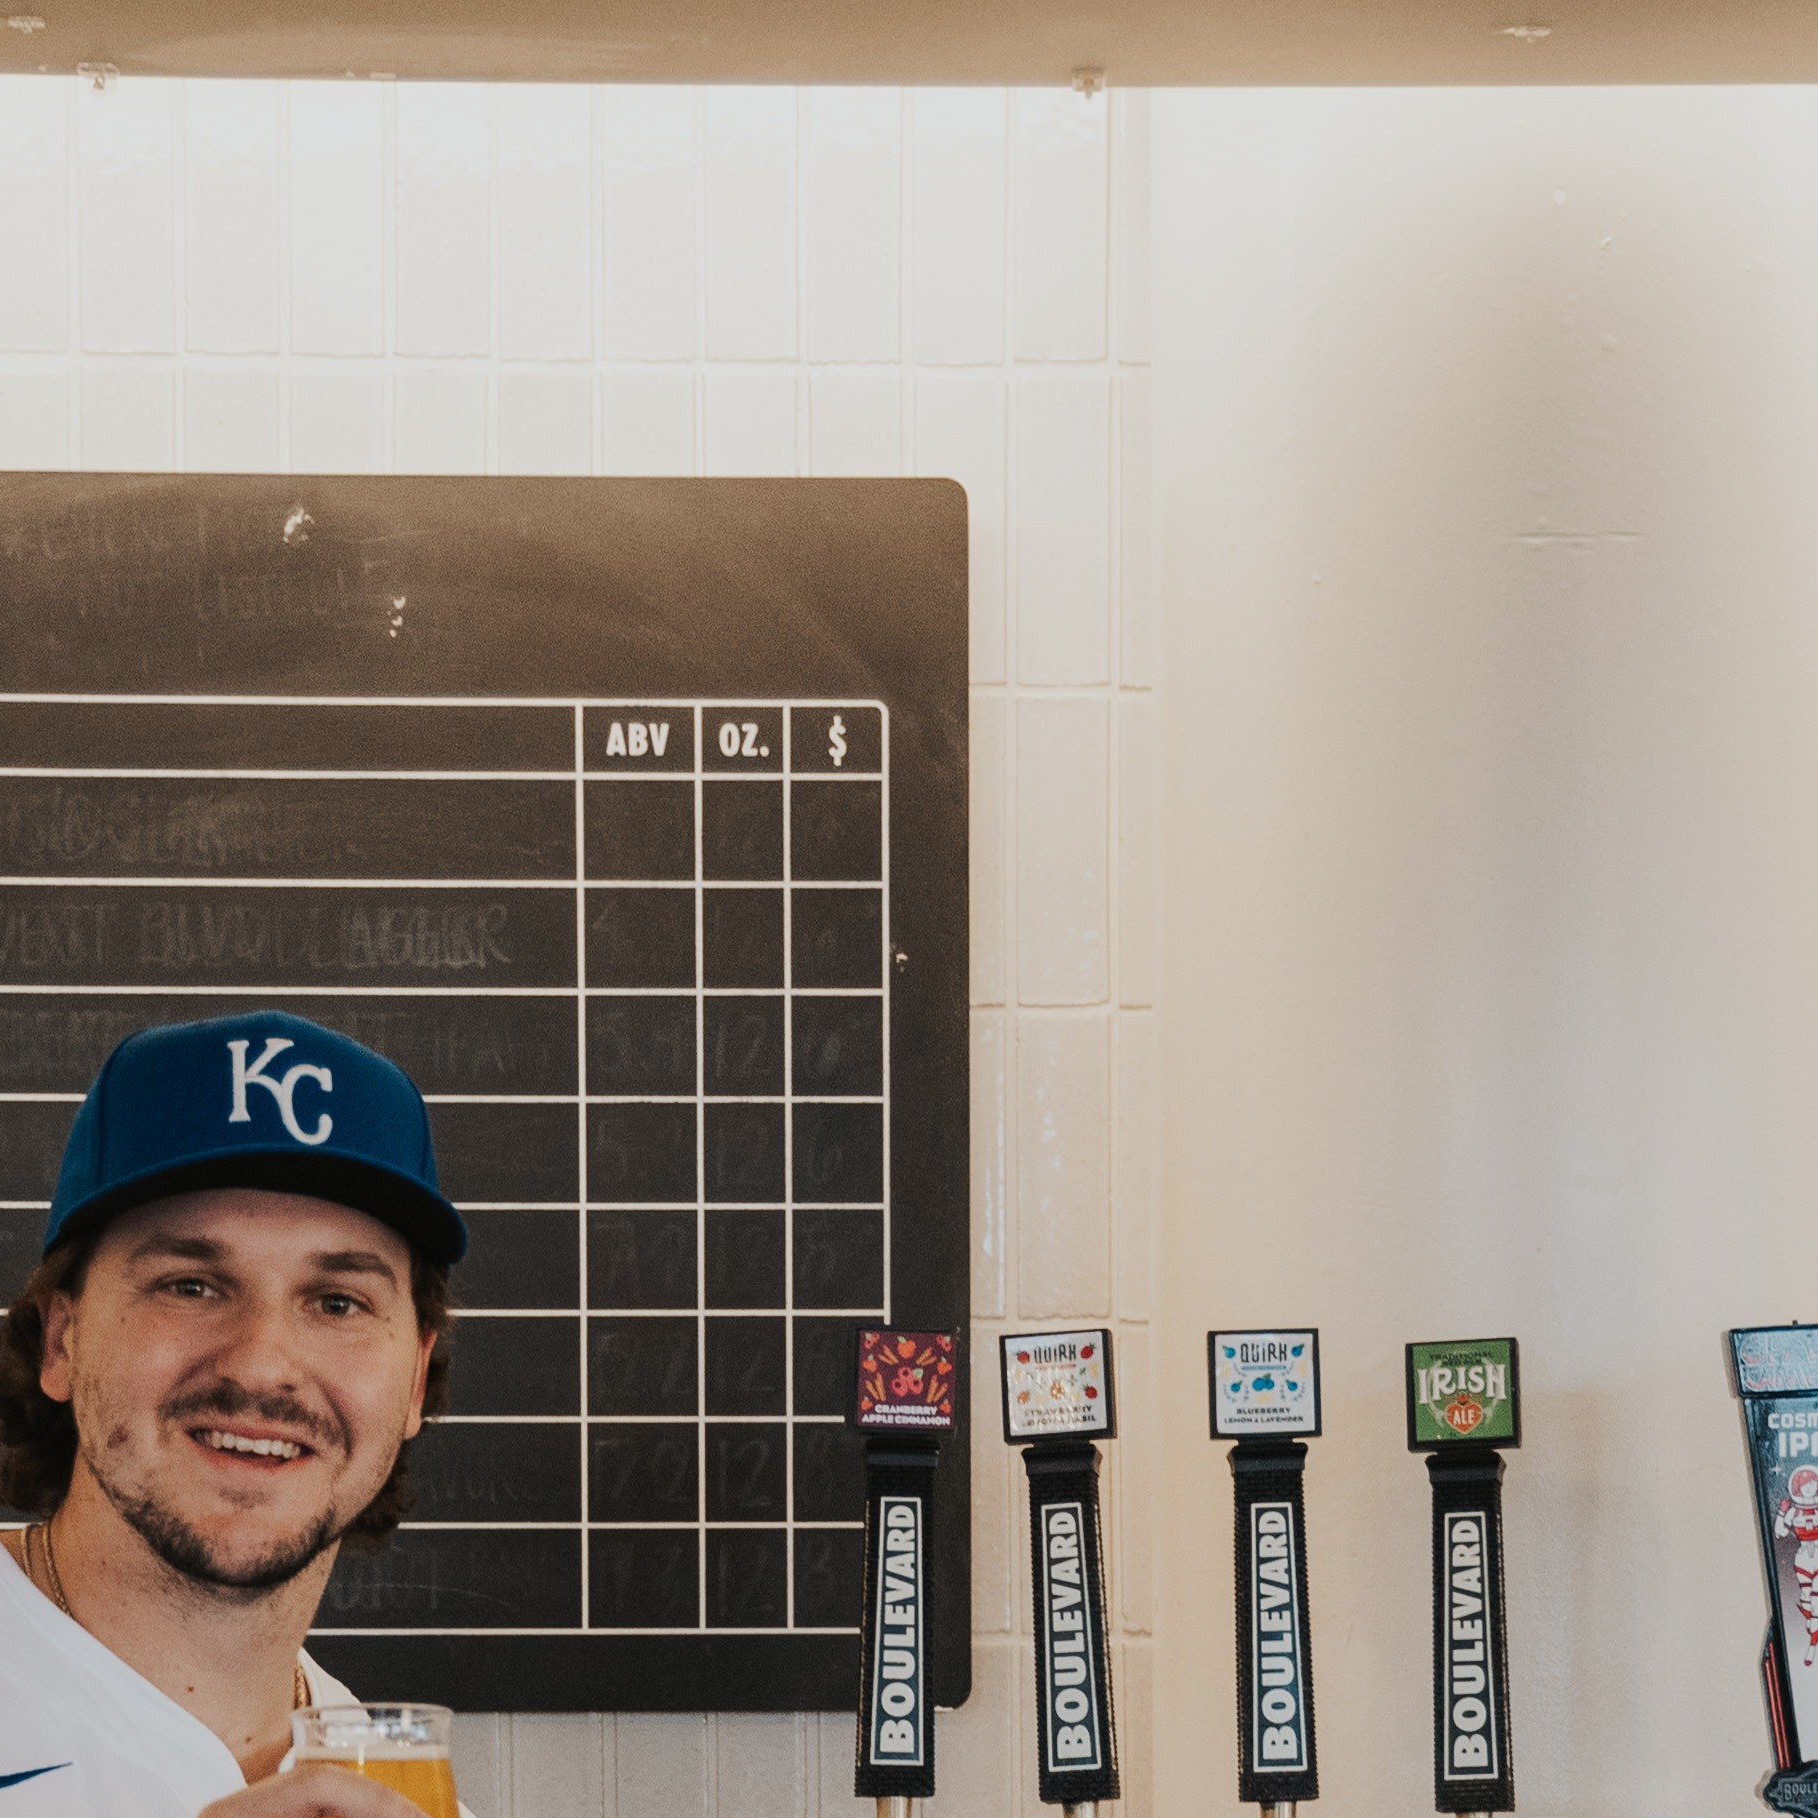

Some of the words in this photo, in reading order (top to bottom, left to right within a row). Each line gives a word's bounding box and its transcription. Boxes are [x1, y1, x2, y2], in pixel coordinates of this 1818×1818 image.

[605, 721, 670, 757] ABV
[718, 721, 770, 757] OZ.
[828, 714, 848, 767] $
[226, 1037, 333, 1146] KC
[1416, 1363, 1507, 1405] IRISH
[862, 1414, 894, 1424] APPLE
[894, 1415, 951, 1425] CINNAMON
[874, 1404, 938, 1415] CRANBERRY
[1453, 1409, 1475, 1425] ALE
[879, 1504, 917, 1754] BOULEVARD
[1048, 1511, 1092, 1760] BOULEVARD
[1258, 1510, 1298, 1761] BOULEVARD
[1451, 1520, 1489, 1768] BOULEVARD
